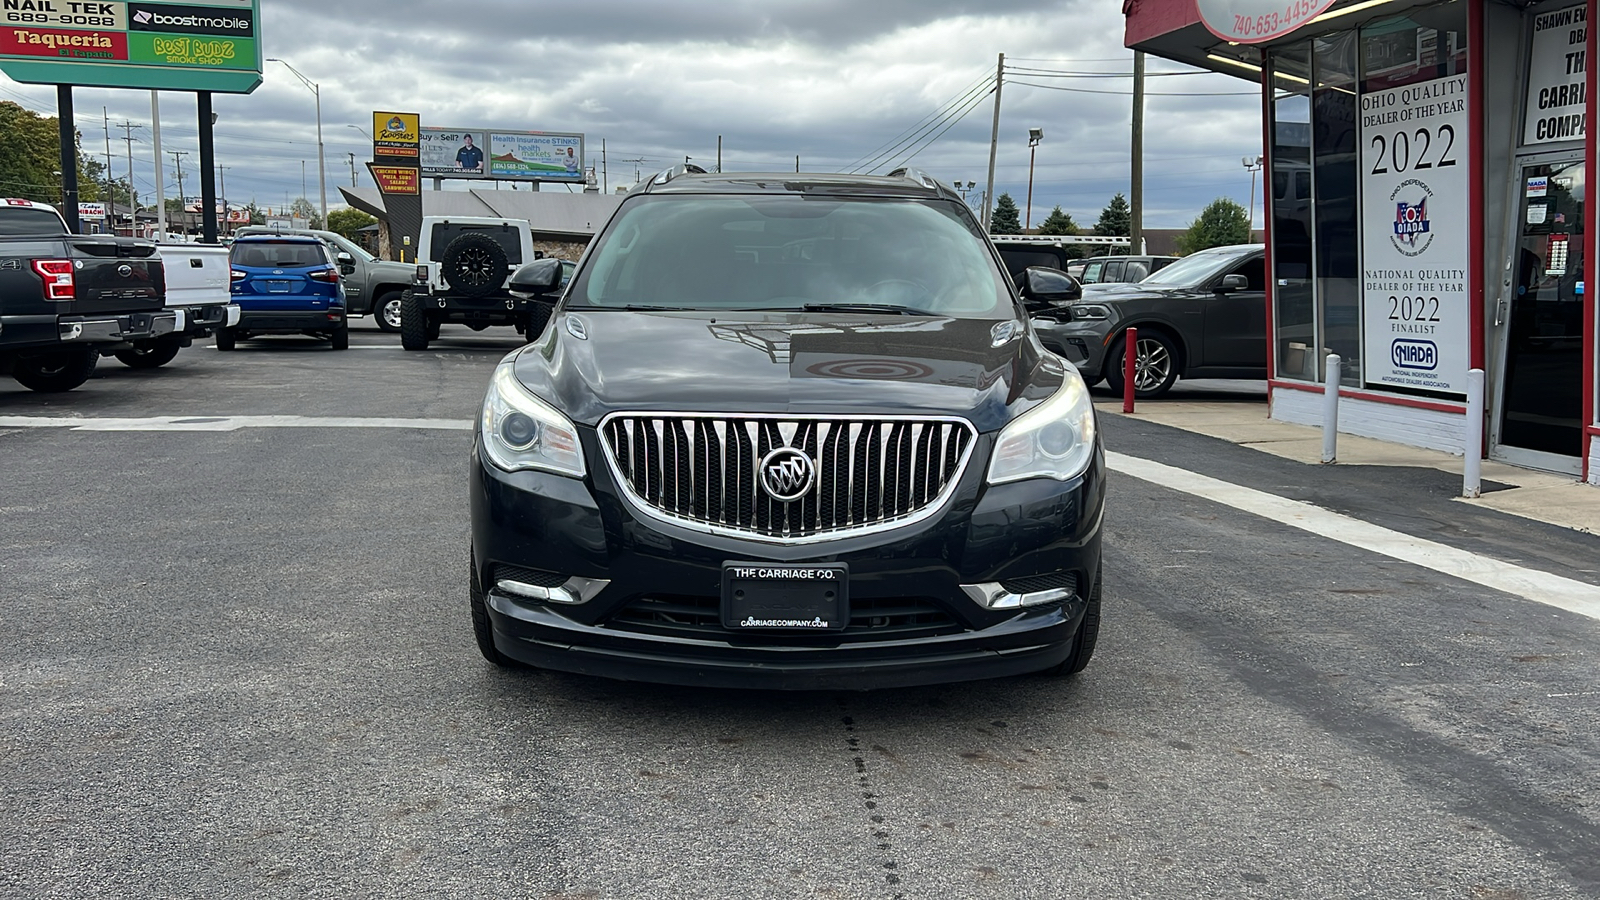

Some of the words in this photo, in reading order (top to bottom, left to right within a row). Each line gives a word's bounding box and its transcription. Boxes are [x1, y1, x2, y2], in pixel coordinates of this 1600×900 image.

[4, 0, 57, 12] NAIL
[67, 2, 115, 15] TEK
[7, 12, 115, 26] 689-9088
[1233, 0, 1318, 35] 740-653-4455
[1535, 10, 1572, 31] SHAWN
[58, 48, 70, 56] El
[193, 40, 235, 59] BUDZ
[166, 55, 197, 64] SMOKE
[199, 56, 223, 65] SHOP
[1565, 51, 1587, 75] TH
[1362, 92, 1396, 111] OHIO
[1401, 78, 1466, 106] QUALITY
[1538, 82, 1587, 110] CARRI
[1364, 111, 1399, 128] DEALER
[1400, 108, 1413, 122] OF
[1415, 104, 1435, 119] THE
[1437, 99, 1464, 114] YEAR
[379, 129, 414, 140] Roosters
[420, 133, 432, 141] Buy
[440, 133, 459, 141] Sell?
[516, 136, 550, 144] Insurance
[518, 144, 540, 152] health
[521, 150, 551, 158] markets
[1371, 124, 1457, 175] 2022
[1390, 185, 1401, 201] OHIO
[1401, 179, 1434, 197] INDEPENDENT
[1397, 222, 1424, 233] OIADA
[1365, 270, 1414, 279] NATIONAL
[1418, 269, 1465, 281] QUALITY
[1366, 282, 1399, 291] DEALER
[1402, 282, 1413, 291] OF
[1417, 282, 1435, 291] THE
[1439, 283, 1464, 292] YEAR
[1388, 295, 1441, 322] 2022
[1391, 323, 1436, 334] FINALIST
[1395, 345, 1434, 364] NIADA
[734, 568, 756, 578] THE
[758, 568, 815, 579] CARRIAGE
[817, 569, 836, 579] CO.
[740, 619, 828, 628] CARRIAGECOMPANY.COM
